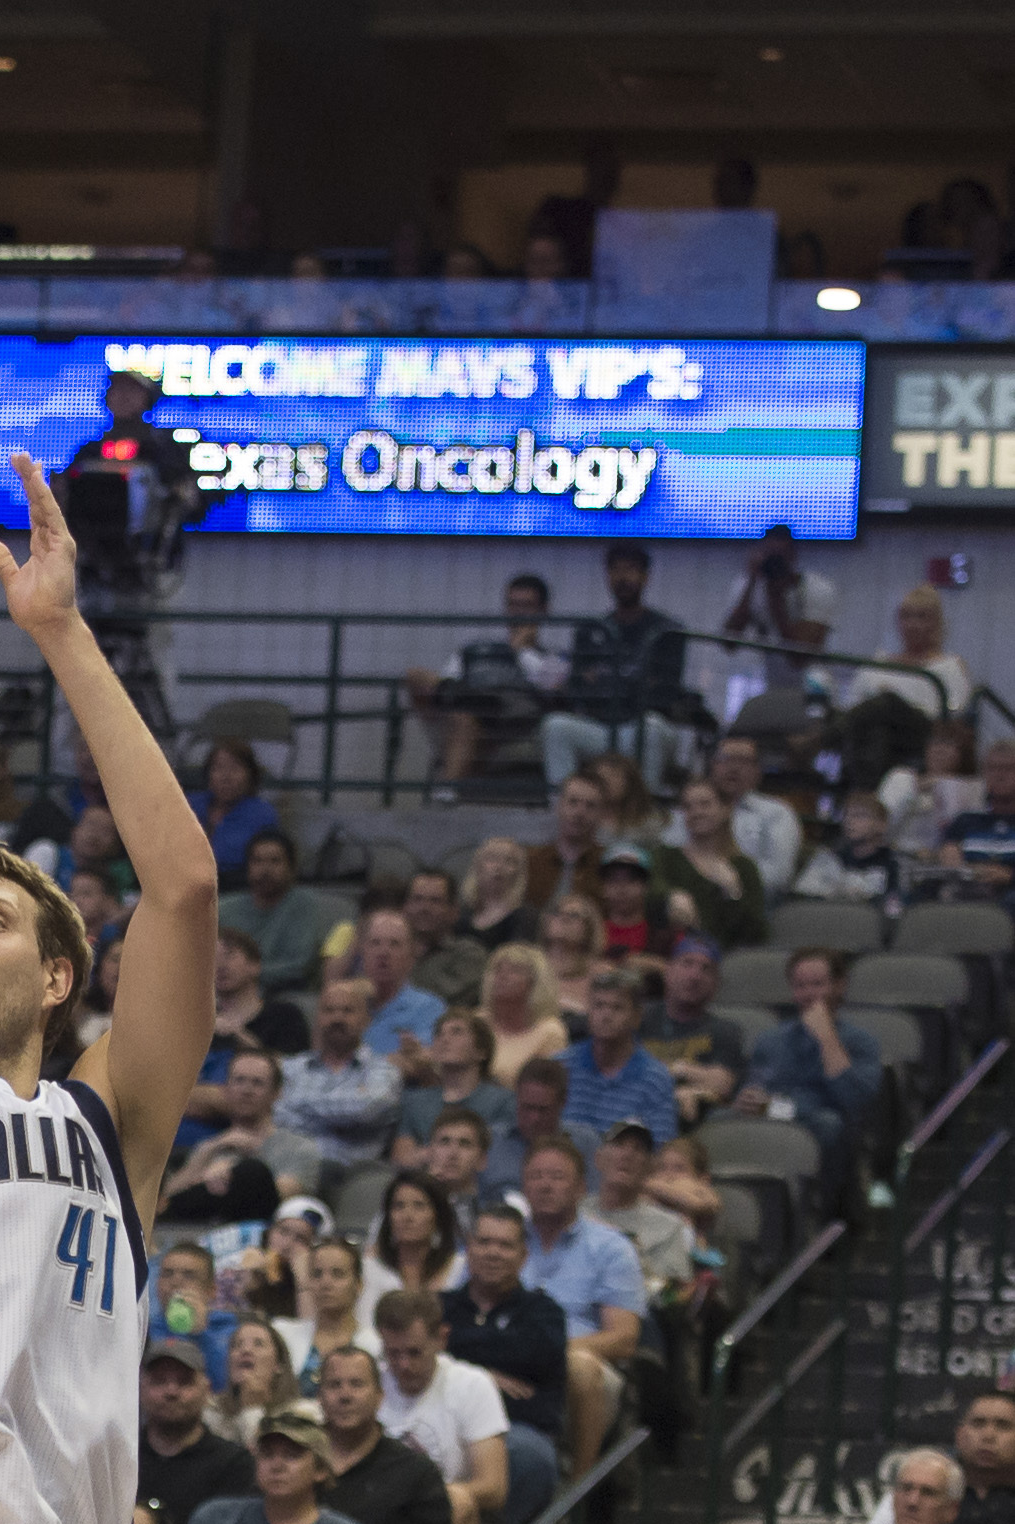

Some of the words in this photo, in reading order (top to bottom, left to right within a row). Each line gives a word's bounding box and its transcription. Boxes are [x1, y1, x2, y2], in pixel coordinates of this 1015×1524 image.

[172, 428, 328, 490] exas
[342, 428, 656, 509] Oncology
[55, 1203, 118, 1318] 41
